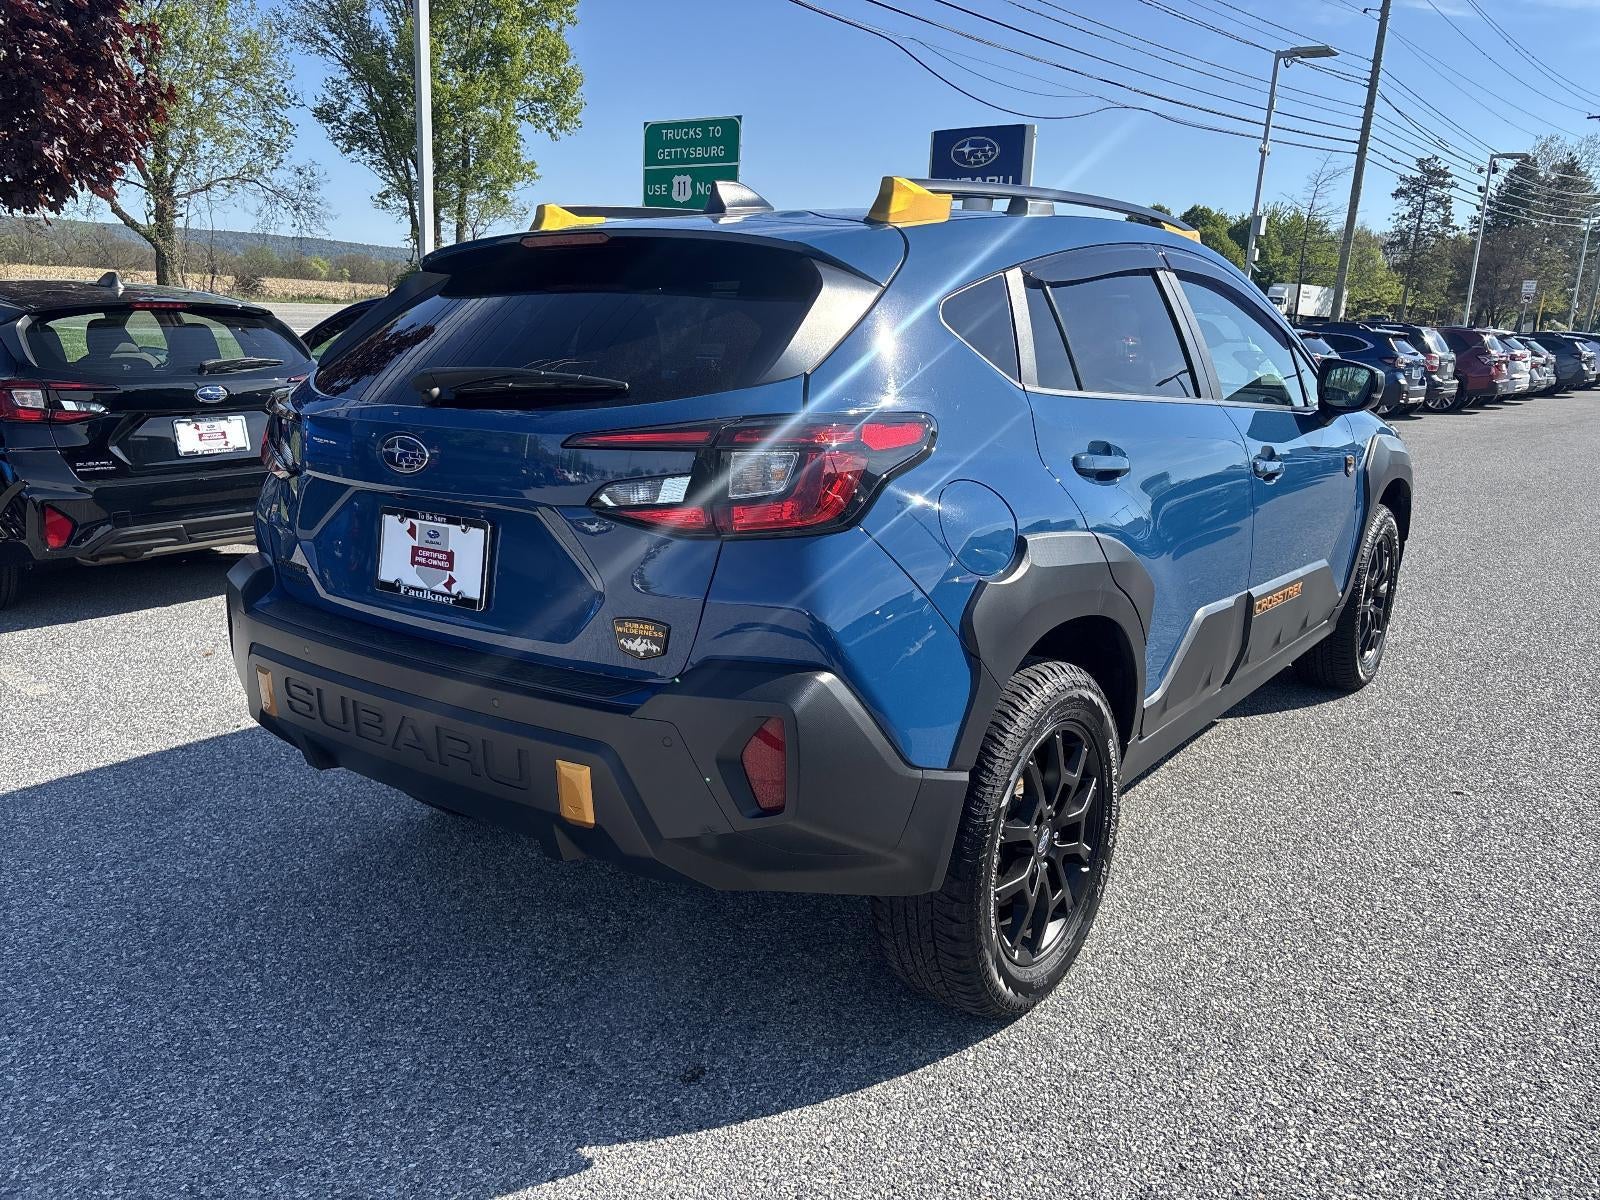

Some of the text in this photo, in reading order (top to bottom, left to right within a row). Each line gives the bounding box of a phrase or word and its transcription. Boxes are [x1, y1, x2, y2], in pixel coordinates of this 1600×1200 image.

[661, 126, 722, 141] TRUCKS TO
[657, 145, 725, 160] GETTYSBURG
[647, 184, 668, 195] USE
[677, 181, 687, 197] 11
[414, 556, 450, 568] PRE-OWNED
[418, 549, 447, 560] CERTIFIED
[400, 584, 456, 605] Faulkner
[1255, 581, 1304, 615] CROSSTREK
[616, 626, 664, 638] WILDERNESS
[624, 621, 655, 631] SUBARU
[284, 676, 532, 791] SUBARU
